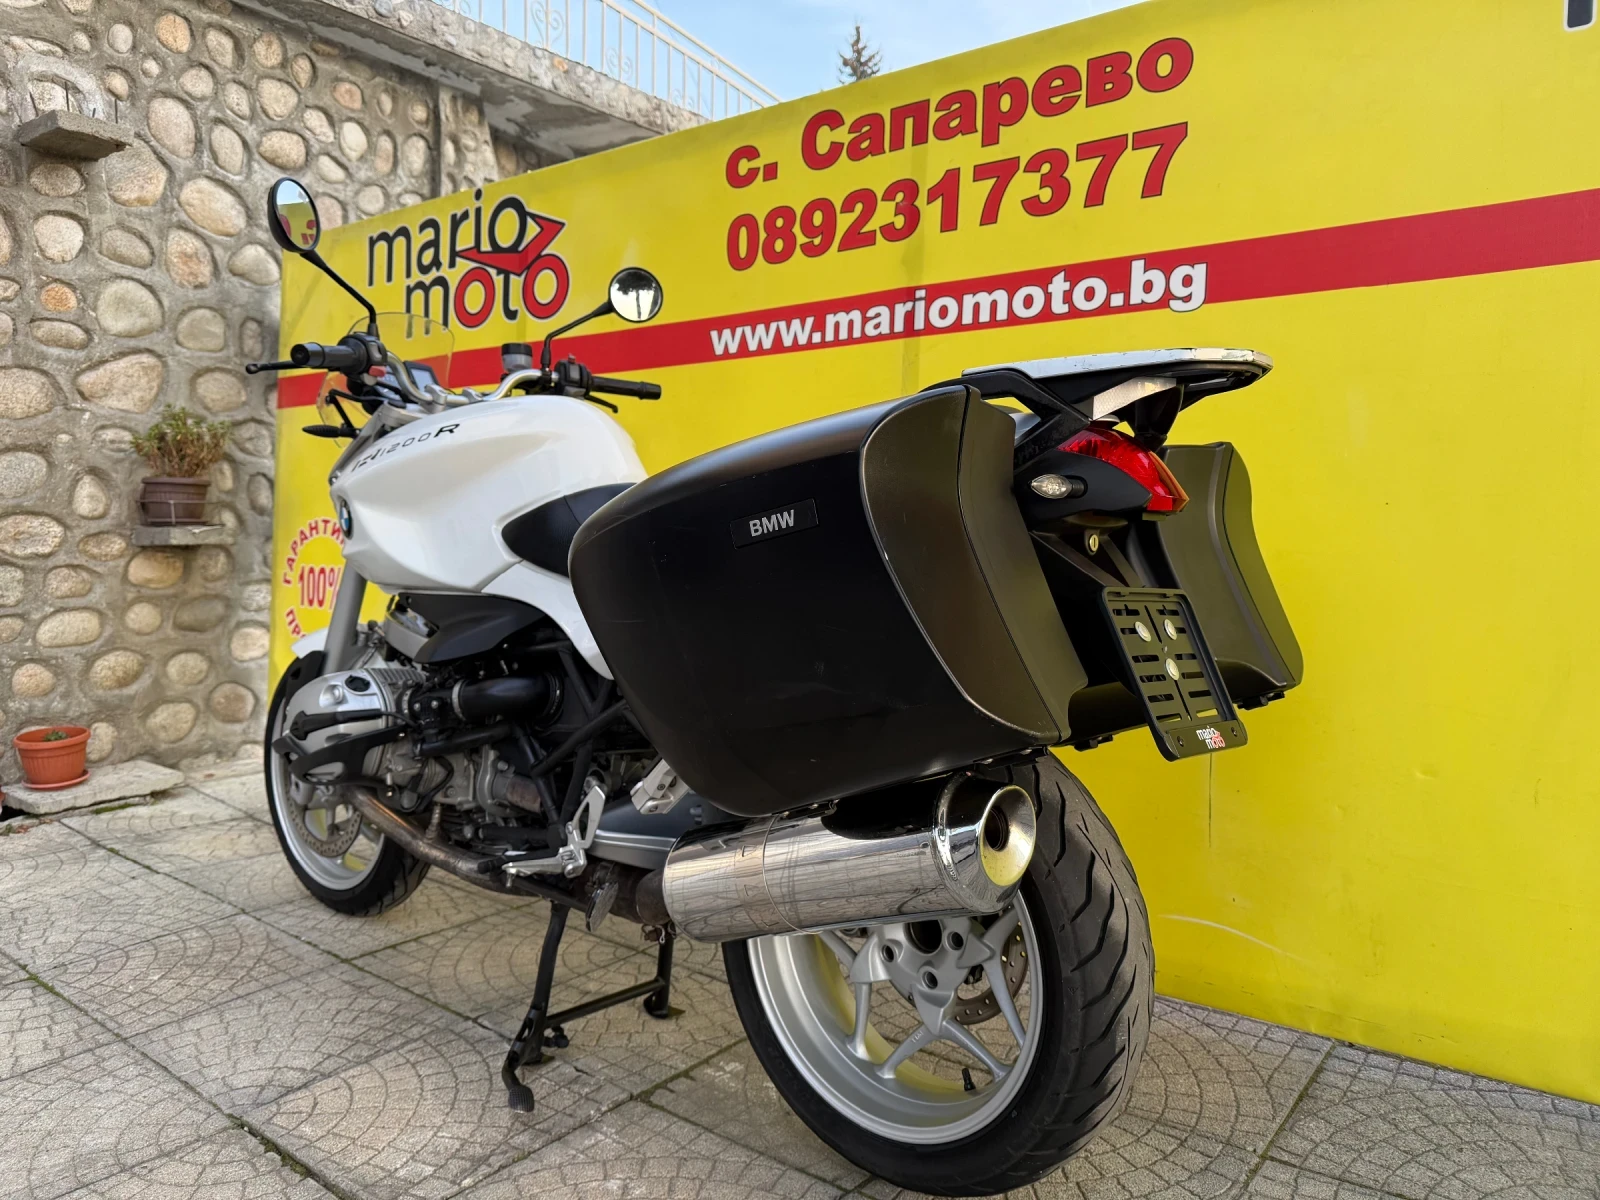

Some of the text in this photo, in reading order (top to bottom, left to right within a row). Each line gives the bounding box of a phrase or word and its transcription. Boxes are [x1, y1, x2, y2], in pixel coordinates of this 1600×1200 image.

[726, 37, 1194, 189] с. Сапарево
[367, 188, 529, 288] mario
[726, 121, 1189, 271] 0892317377
[405, 253, 570, 339] moto
[710, 258, 1208, 355] www.mariomoto.bg
[283, 519, 345, 585] ГАРАНТИ
[749, 509, 795, 537] BMW
